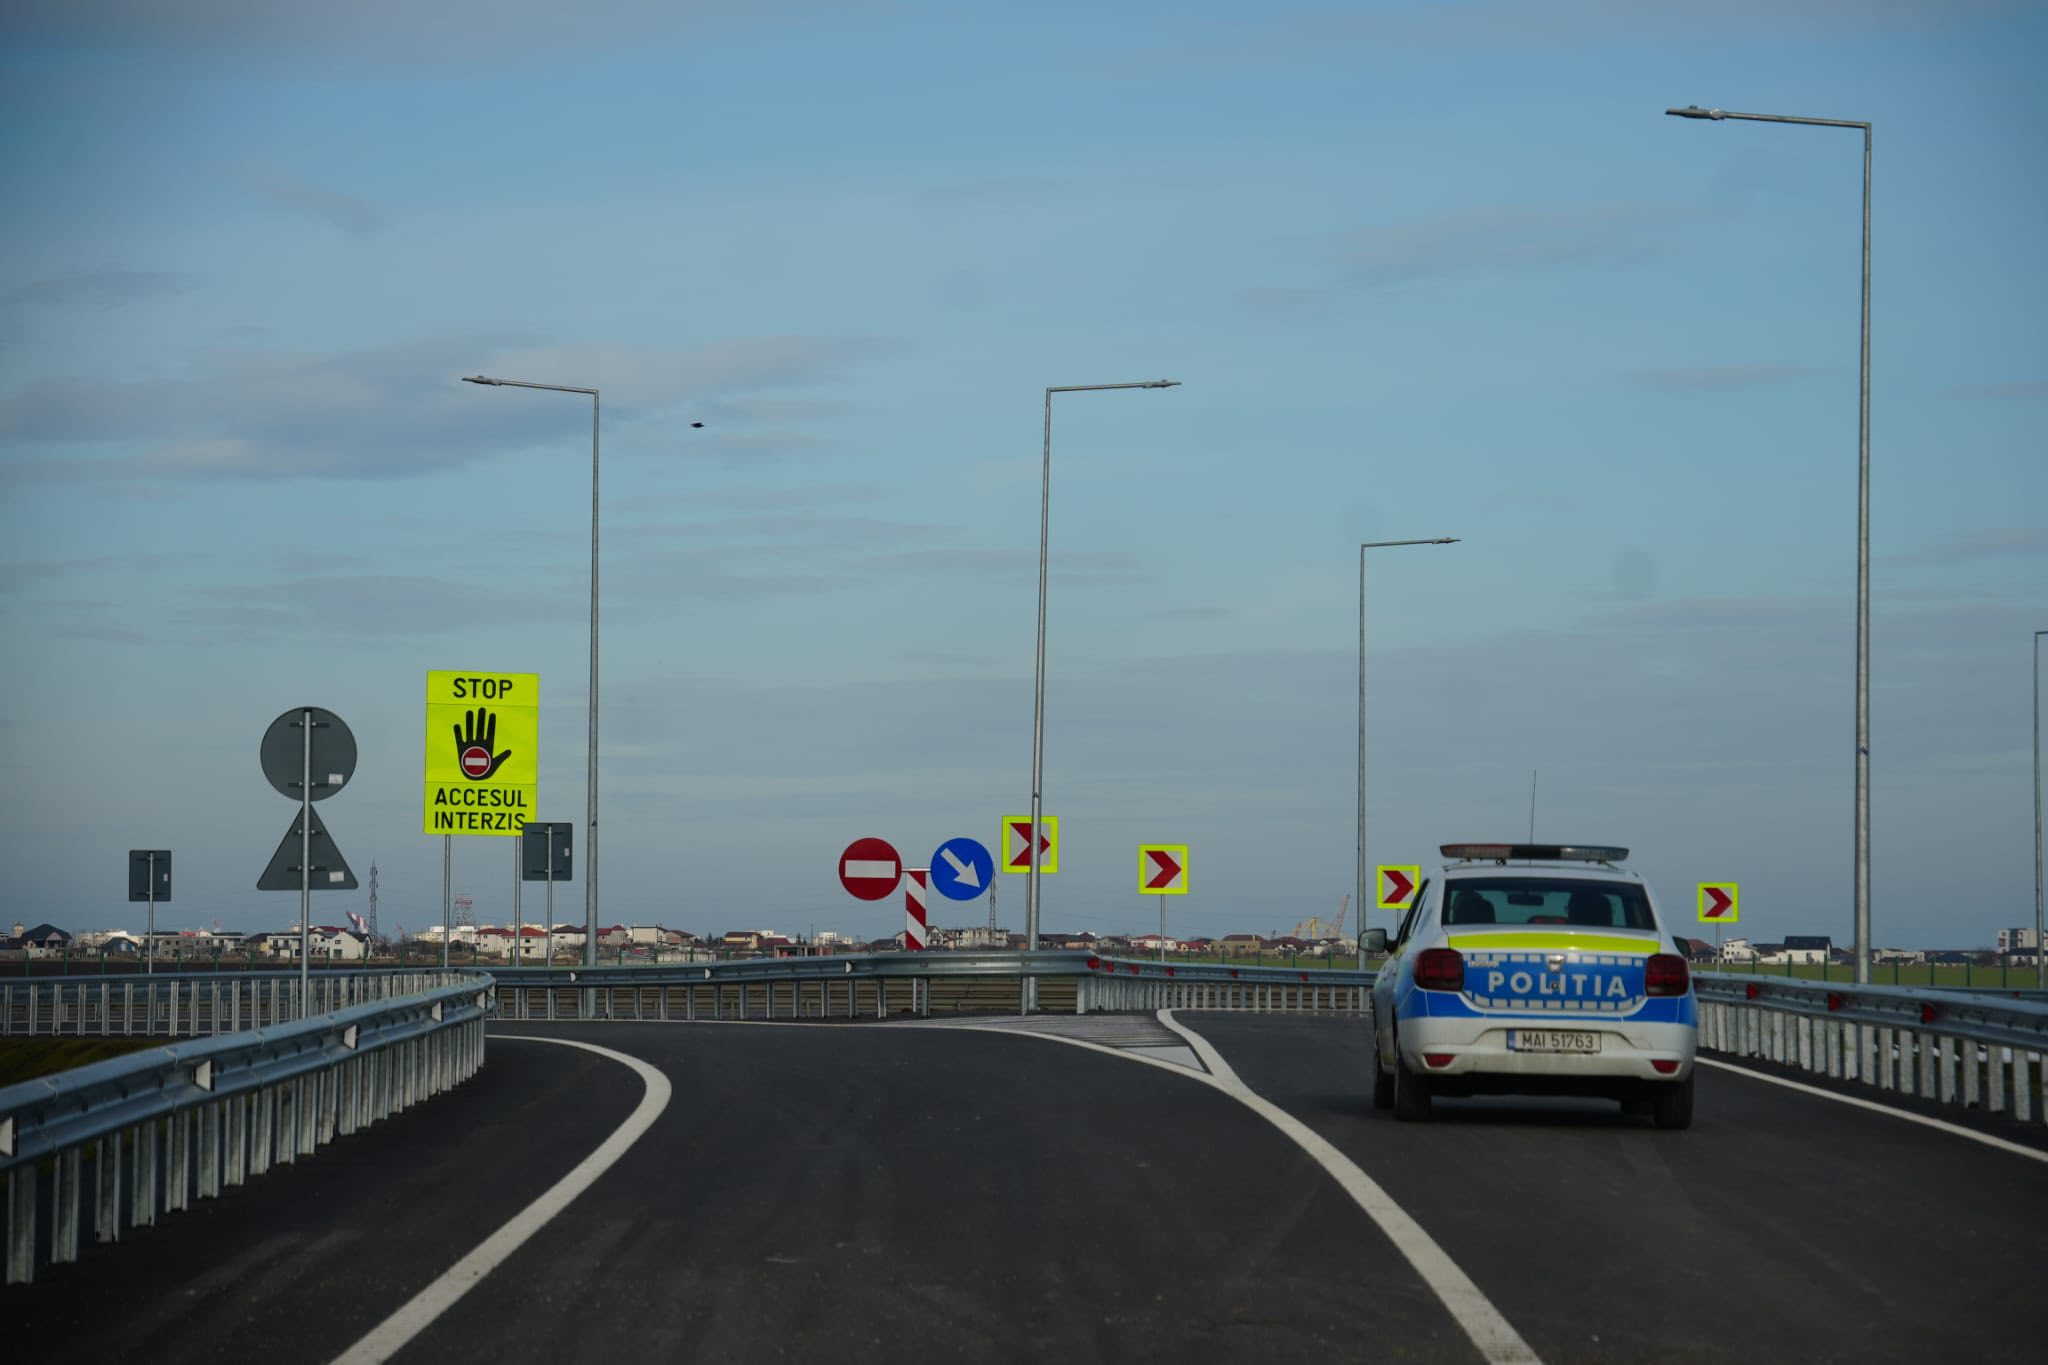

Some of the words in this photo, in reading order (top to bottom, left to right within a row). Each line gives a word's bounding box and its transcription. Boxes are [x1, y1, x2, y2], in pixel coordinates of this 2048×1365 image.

[453, 677, 513, 699] STOP
[435, 788, 528, 807] ACCESUL
[434, 811, 526, 830] INTERZIS
[1488, 971, 1627, 998] POLITIA
[1522, 1032, 1546, 1048] MAI
[1551, 1033, 1594, 1049] 51763
